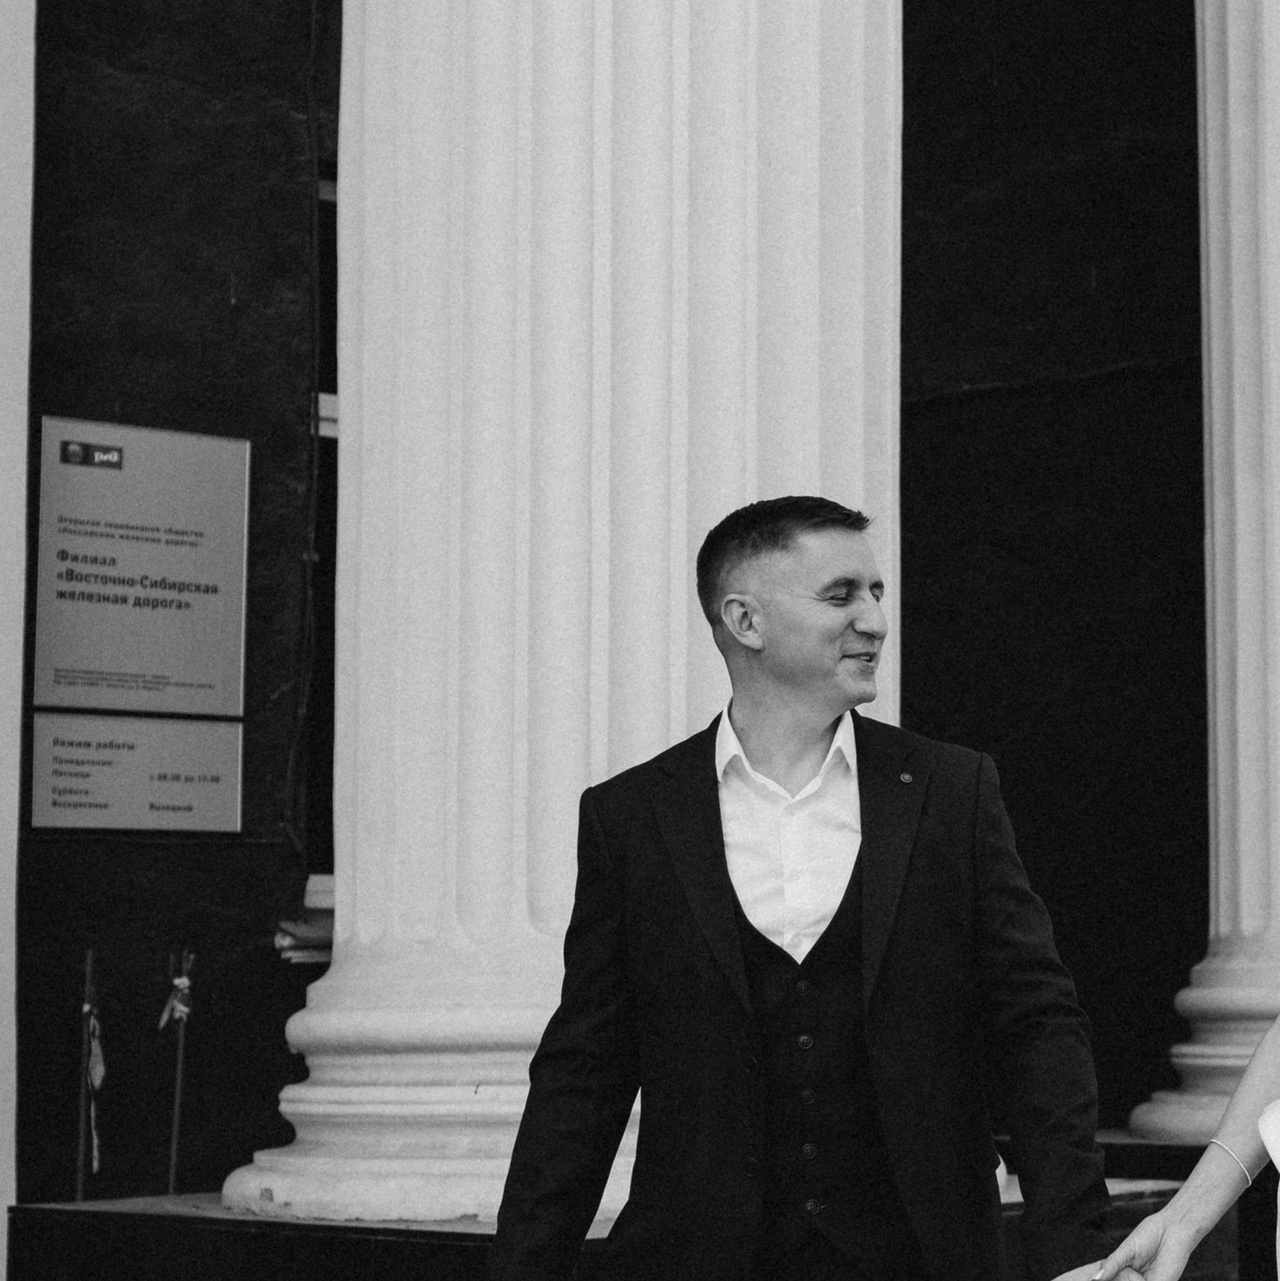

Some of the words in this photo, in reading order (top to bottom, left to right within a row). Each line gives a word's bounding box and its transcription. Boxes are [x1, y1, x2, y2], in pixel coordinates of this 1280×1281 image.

[56, 549, 116, 566] Филиал
[57, 568, 218, 595] «Восточно-Сибирская
[56, 589, 128, 605] железная
[132, 595, 190, 610] дорога»
[95, 740, 134, 751] работы
